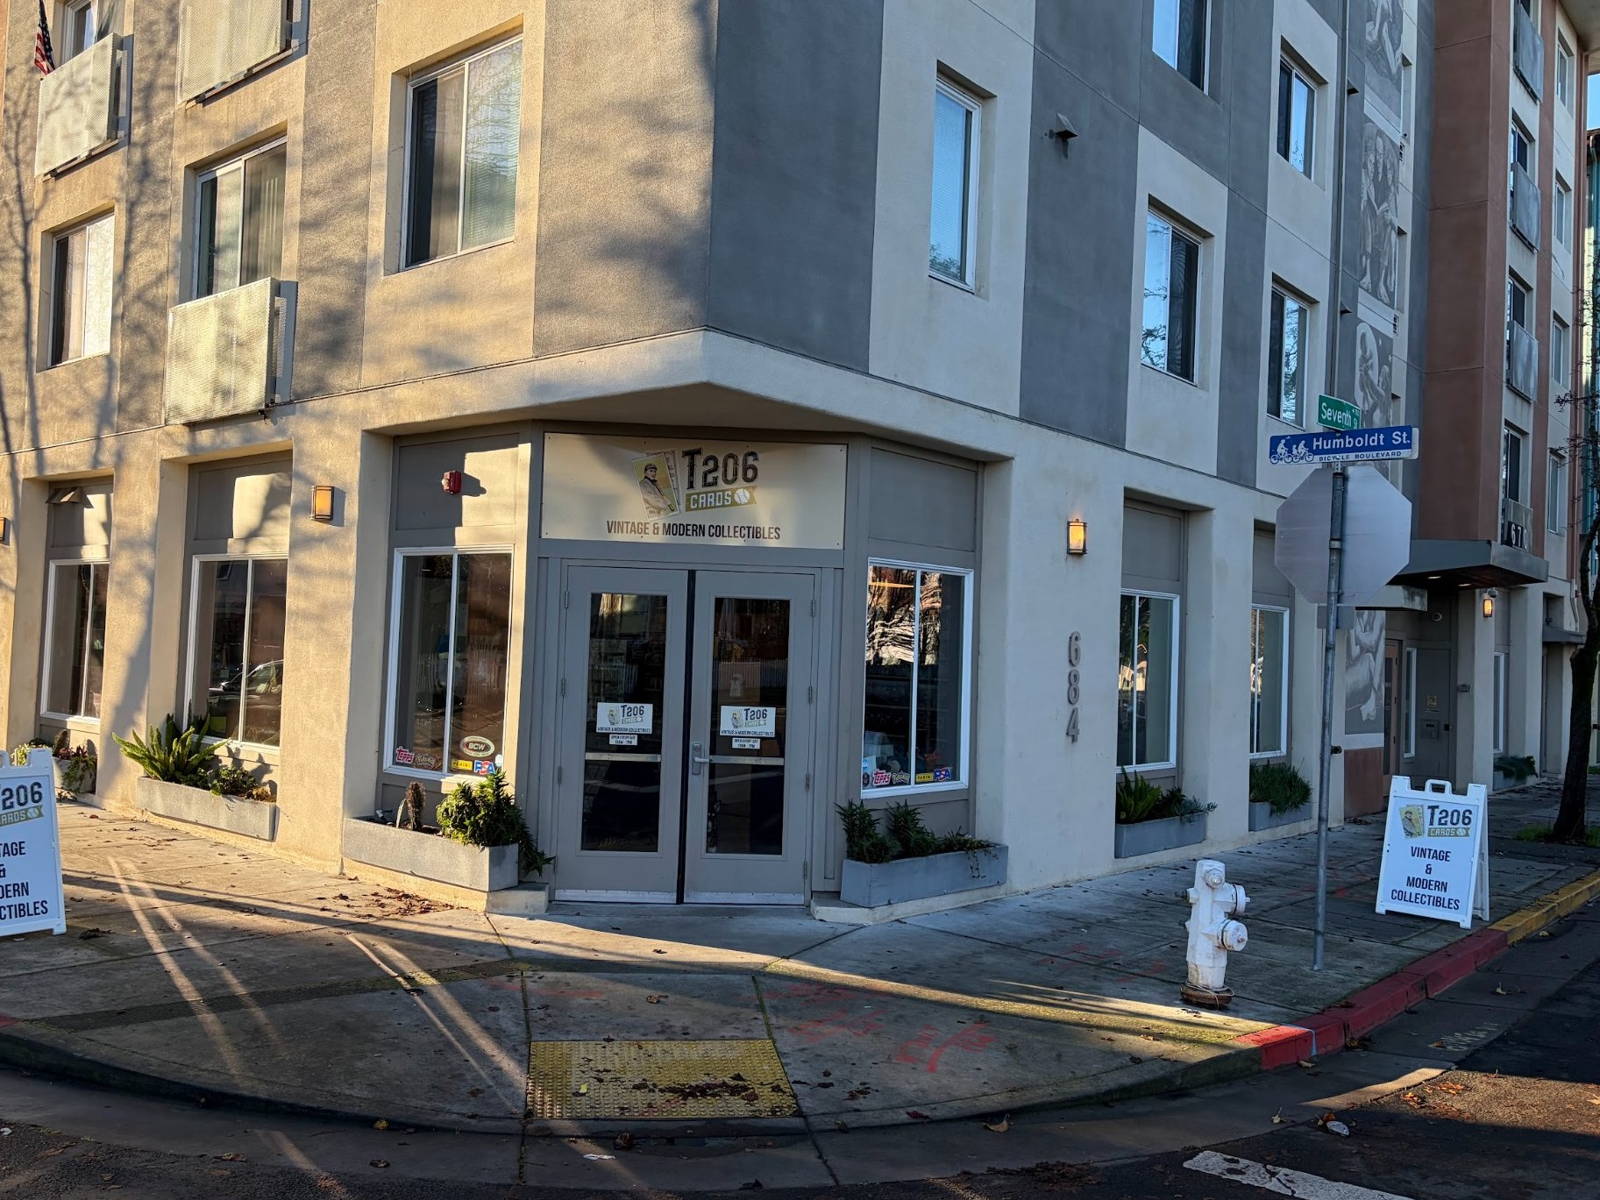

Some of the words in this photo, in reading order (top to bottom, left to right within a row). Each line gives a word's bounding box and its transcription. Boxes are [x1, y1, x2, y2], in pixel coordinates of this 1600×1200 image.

[1321, 402, 1352, 427] Seventh
[1313, 433, 1385, 450] Humboldt
[1392, 431, 1411, 445] St.
[1354, 451, 1402, 459] BOULEVARD
[681, 447, 760, 490] T206
[690, 490, 732, 509] CARDS
[606, 520, 650, 535] VINTAGE
[652, 522, 660, 535] &
[662, 522, 706, 537] MODERN
[708, 524, 781, 540] COLLECTIBLES
[1065, 631, 1081, 744] 684
[620, 704, 645, 718] T206
[743, 707, 768, 721] T206
[0, 782, 43, 810] 206
[0, 810, 26, 825] ARDS
[1427, 805, 1473, 826] T206
[1430, 828, 1456, 836] CARDS
[1410, 846, 1452, 862] VINTAGE
[1425, 863, 1433, 875] &
[1406, 876, 1448, 893] MODERN
[1390, 889, 1461, 911] COLLECTIBLES
